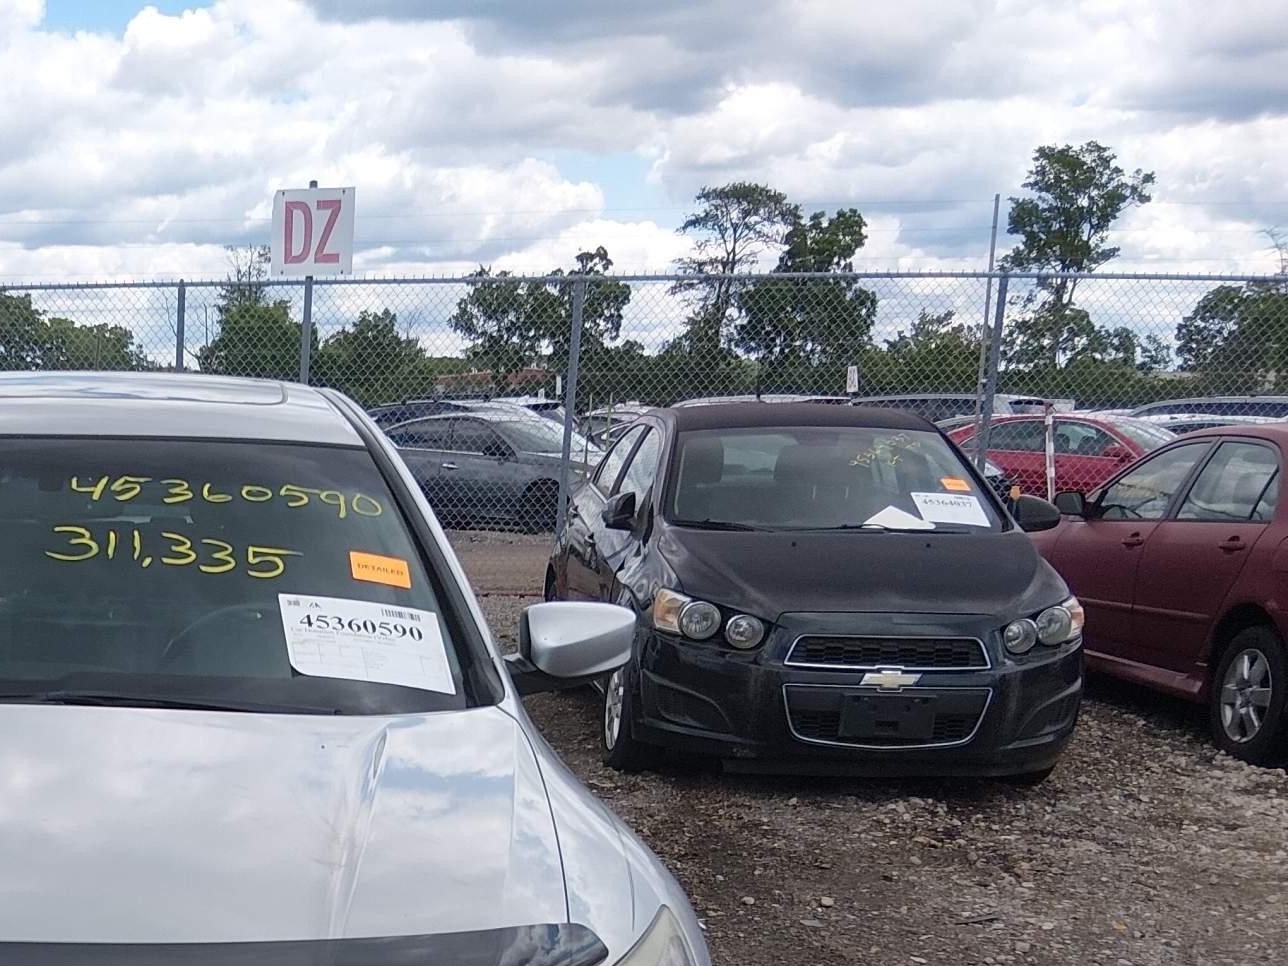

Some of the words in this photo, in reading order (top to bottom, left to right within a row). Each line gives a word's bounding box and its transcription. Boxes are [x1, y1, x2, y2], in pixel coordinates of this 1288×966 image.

[283, 199, 342, 265] DZ
[70, 474, 383, 519] 45360590
[44, 525, 304, 579] 311,335
[357, 562, 405, 577] DETAILED
[299, 613, 424, 642] 45360590
